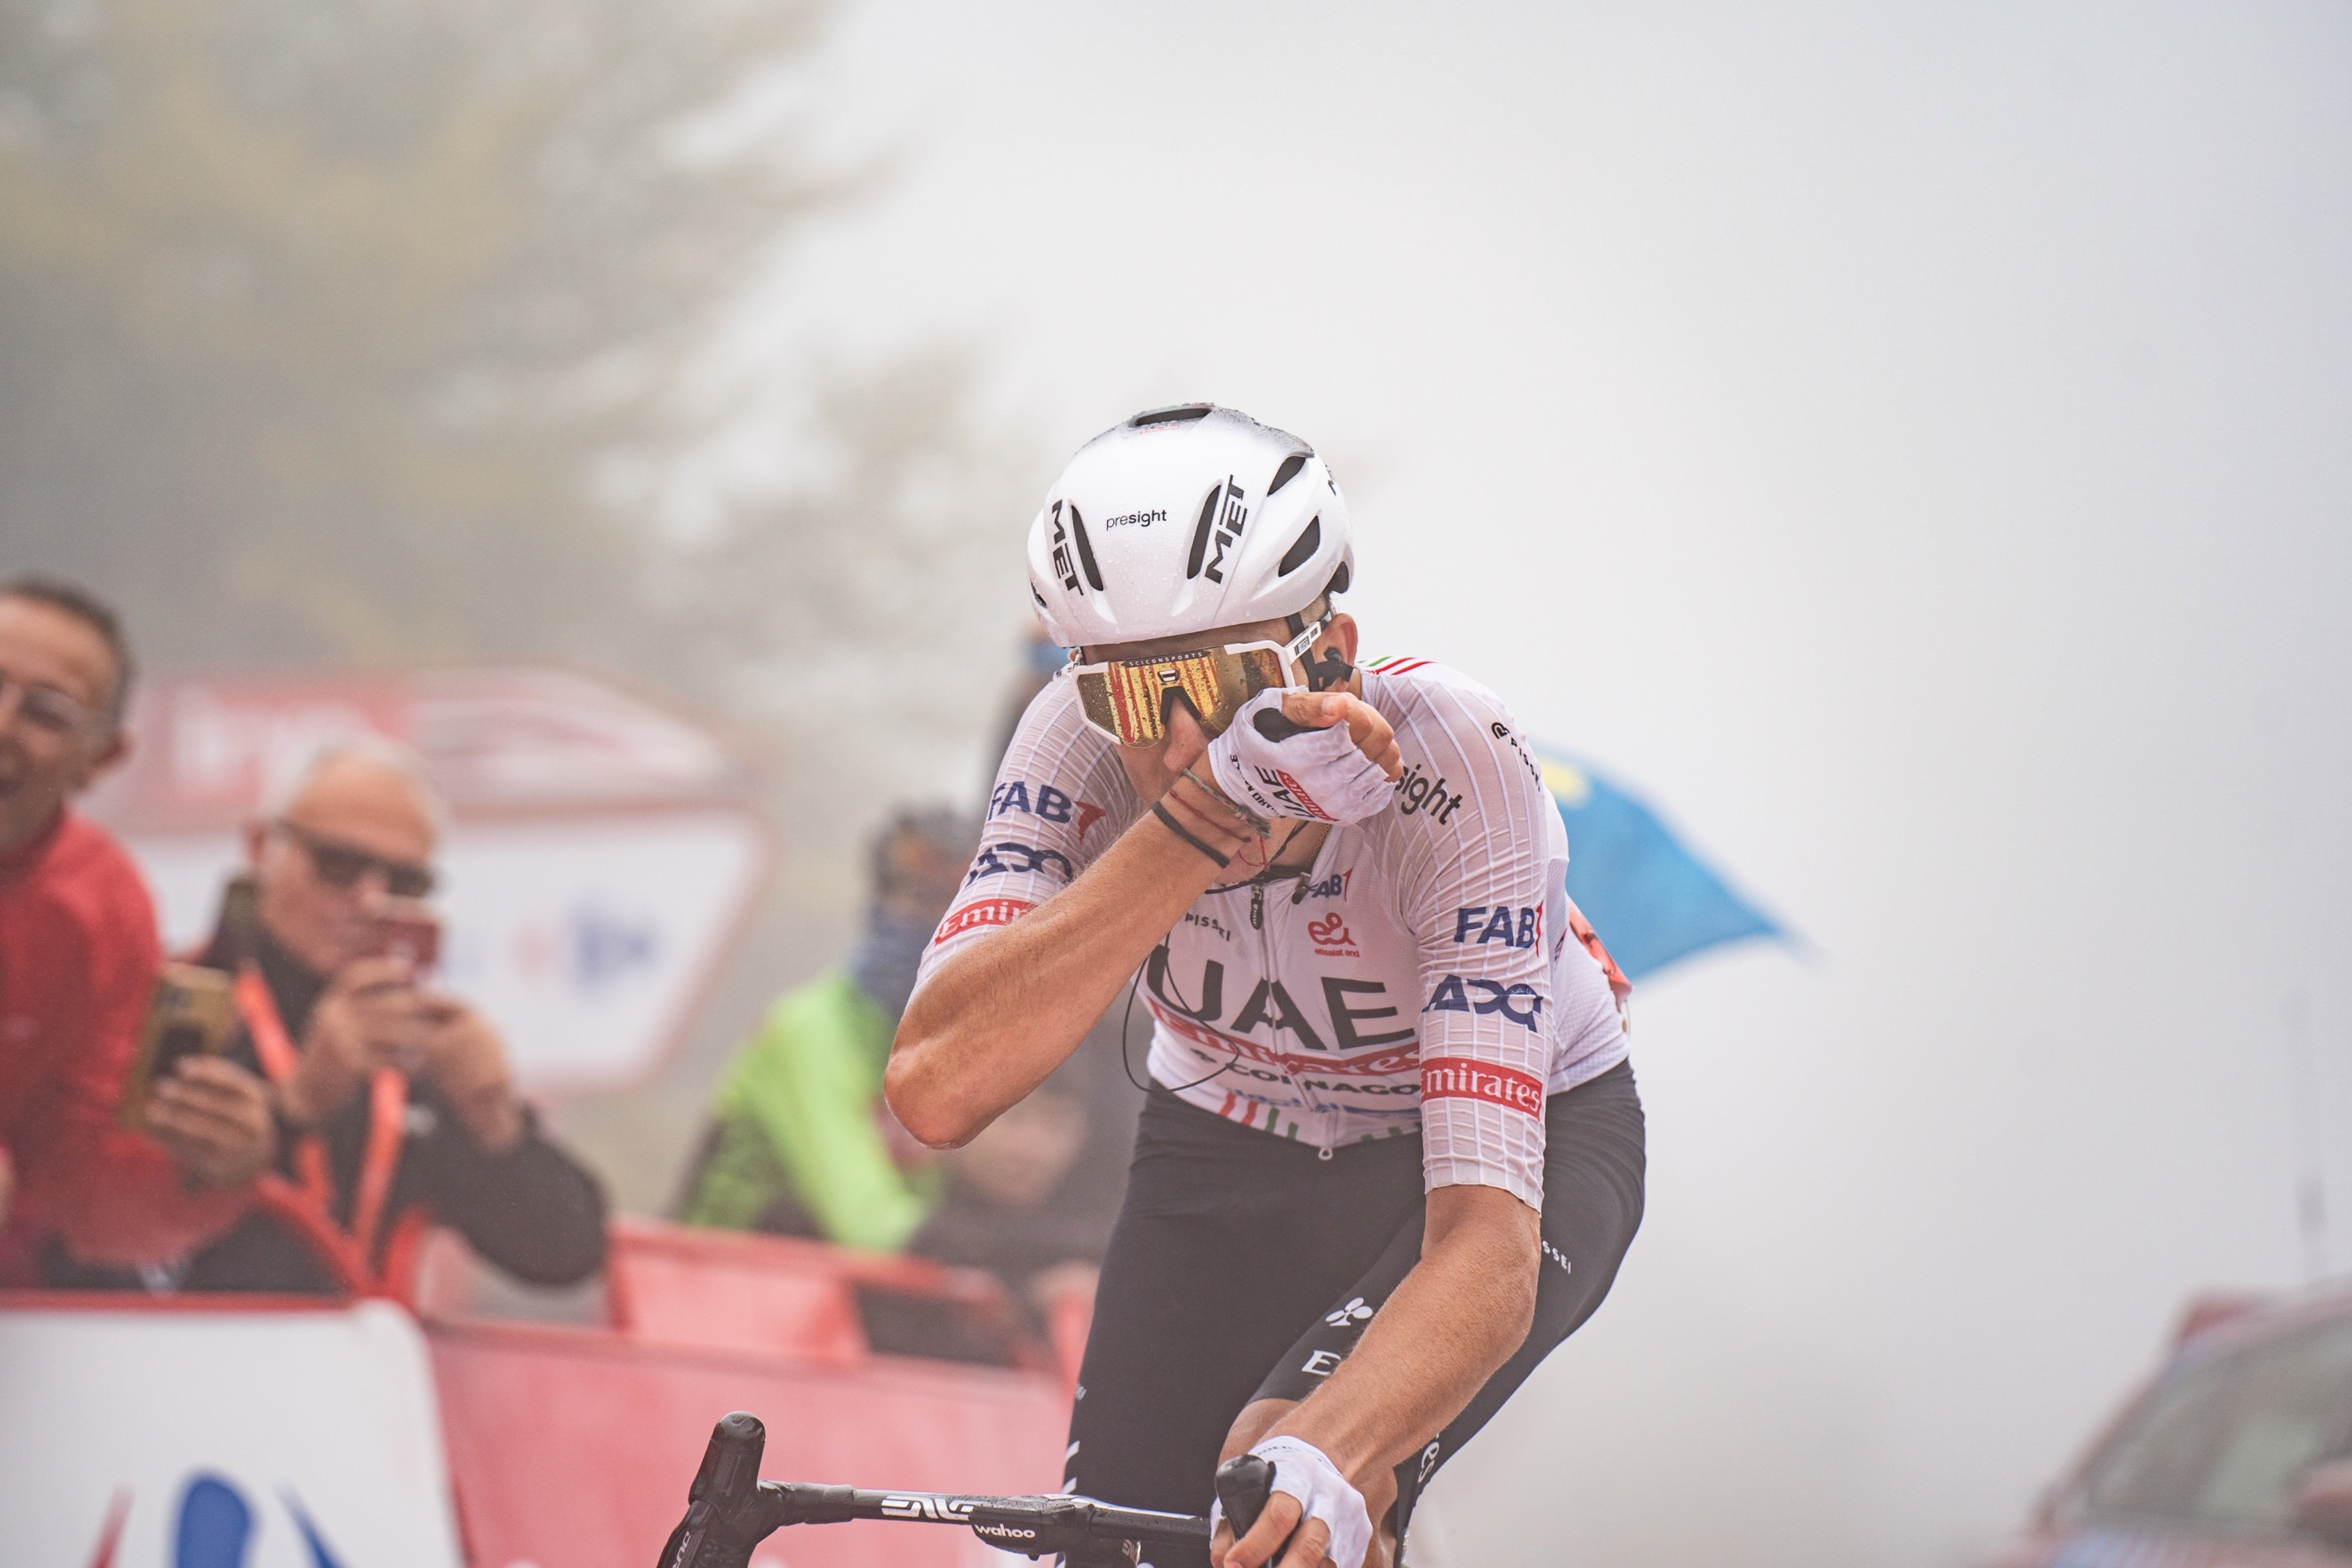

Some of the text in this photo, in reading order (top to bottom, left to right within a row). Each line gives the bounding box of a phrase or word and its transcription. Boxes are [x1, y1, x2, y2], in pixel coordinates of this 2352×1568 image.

[1105, 509, 1167, 531] presight
[1205, 474, 1247, 584] MET
[1051, 498, 1084, 596] MET
[1128, 651, 1203, 667] SCICONSPORTS
[939, 901, 1030, 938] Emir
[1147, 944, 1415, 1051] UAE
[1542, 1240, 1571, 1274] SSEI
[974, 1524, 1036, 1539] wahoo
